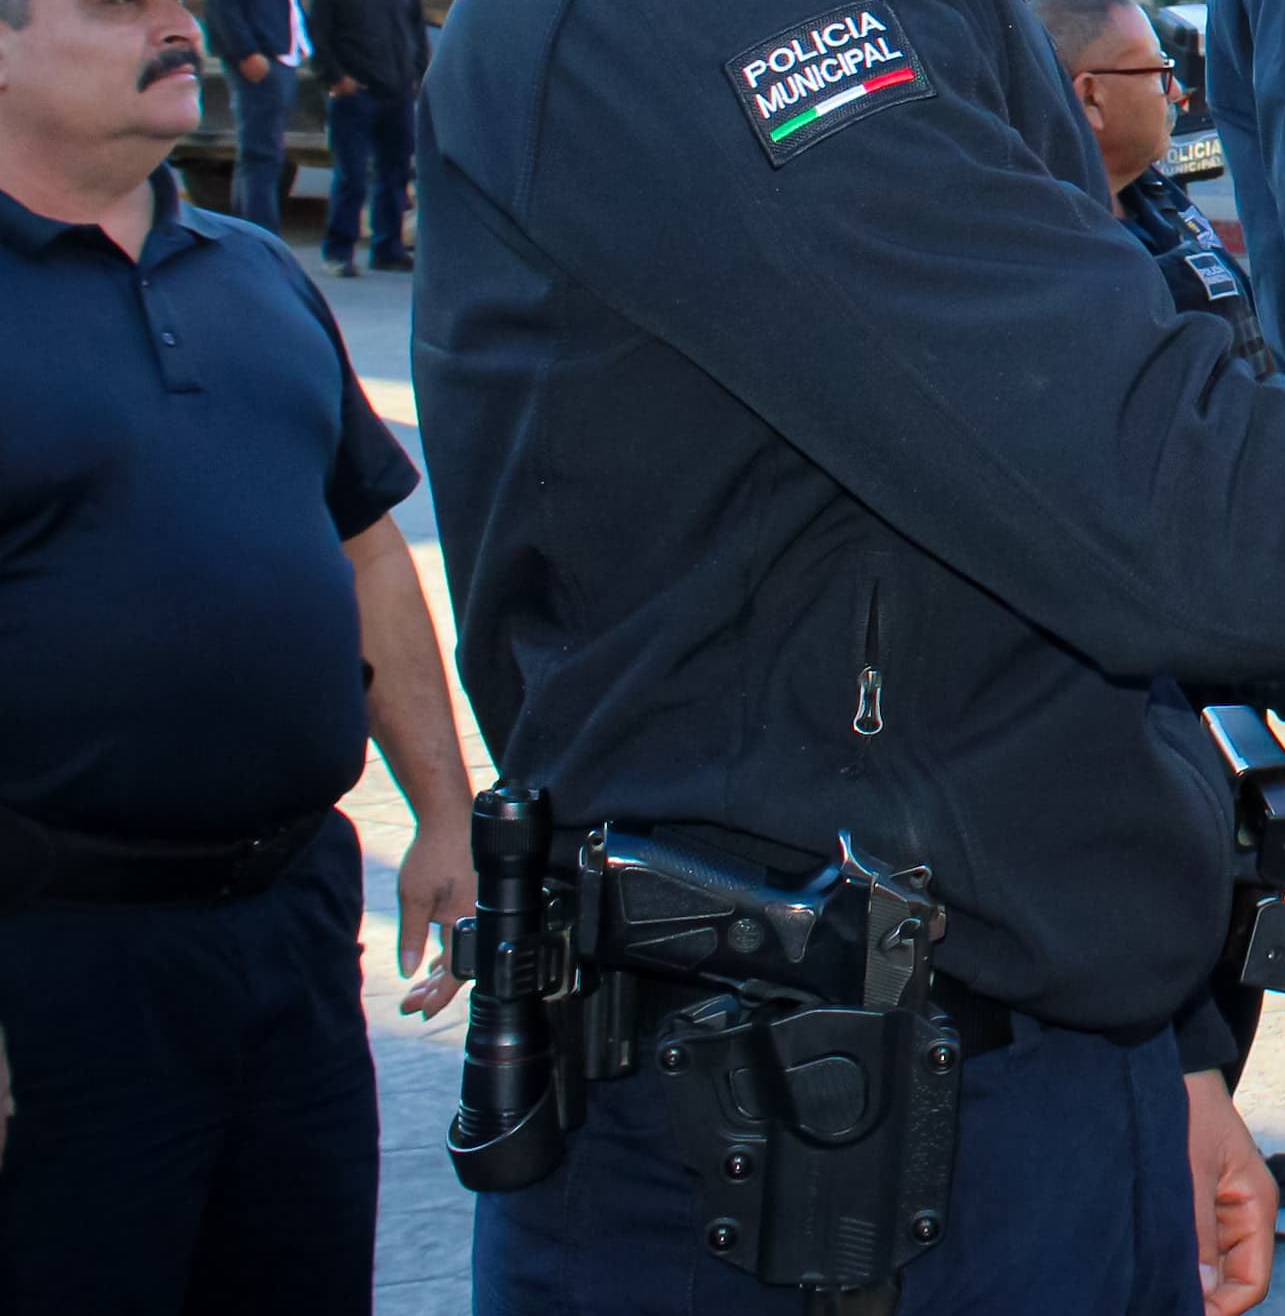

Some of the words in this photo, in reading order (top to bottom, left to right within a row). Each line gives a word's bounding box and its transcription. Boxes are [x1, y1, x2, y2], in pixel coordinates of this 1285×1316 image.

[742, 11, 887, 88] POLICIA
[755, 37, 904, 119] MUNICIPAL
[1166, 140, 1223, 164] OLICIA
